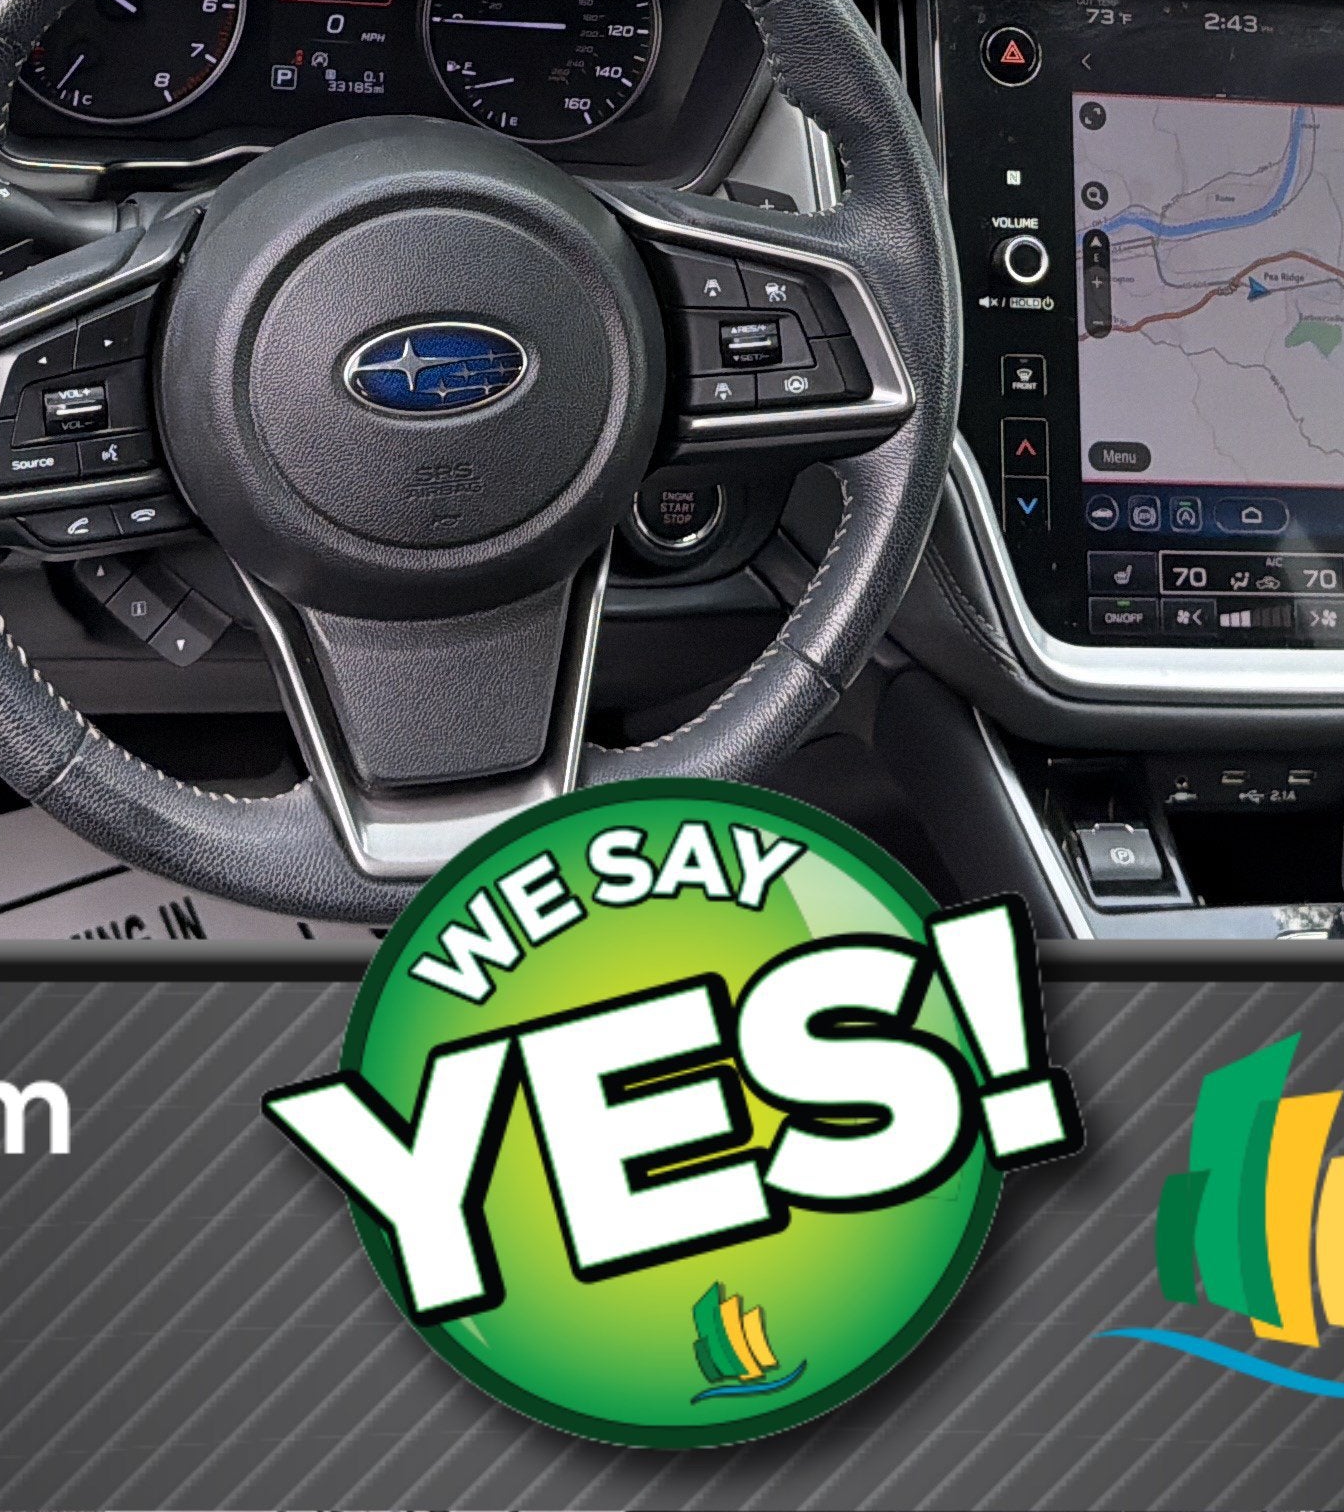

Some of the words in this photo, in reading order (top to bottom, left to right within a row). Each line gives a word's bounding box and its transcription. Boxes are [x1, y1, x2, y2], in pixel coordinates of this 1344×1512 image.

[1086, 8, 1115, 25] 73
[1204, 13, 1258, 33] 2:43
[326, 14, 344, 34] 0
[360, 32, 386, 42] MPH
[607, 25, 634, 38] 120
[190, 43, 205, 58] 7
[276, 69, 293, 85] P
[364, 70, 384, 82] 0.1
[594, 66, 623, 79] 140
[154, 73, 170, 88] 8
[564, 98, 591, 110] 160
[992, 217, 1039, 229] VOLUME
[1010, 298, 1041, 308] HOLD
[58, 388, 92, 400] VOL+
[11, 456, 55, 471] Source
[1102, 450, 1138, 464] Menu
[662, 490, 695, 501] ENGINE
[660, 502, 696, 513] START
[663, 513, 692, 524] STOP
[1172, 566, 1207, 588] 70
[1302, 568, 1338, 589] 70
[1104, 612, 1143, 624] ON/OFF
[1270, 789, 1298, 803] 2.1A
